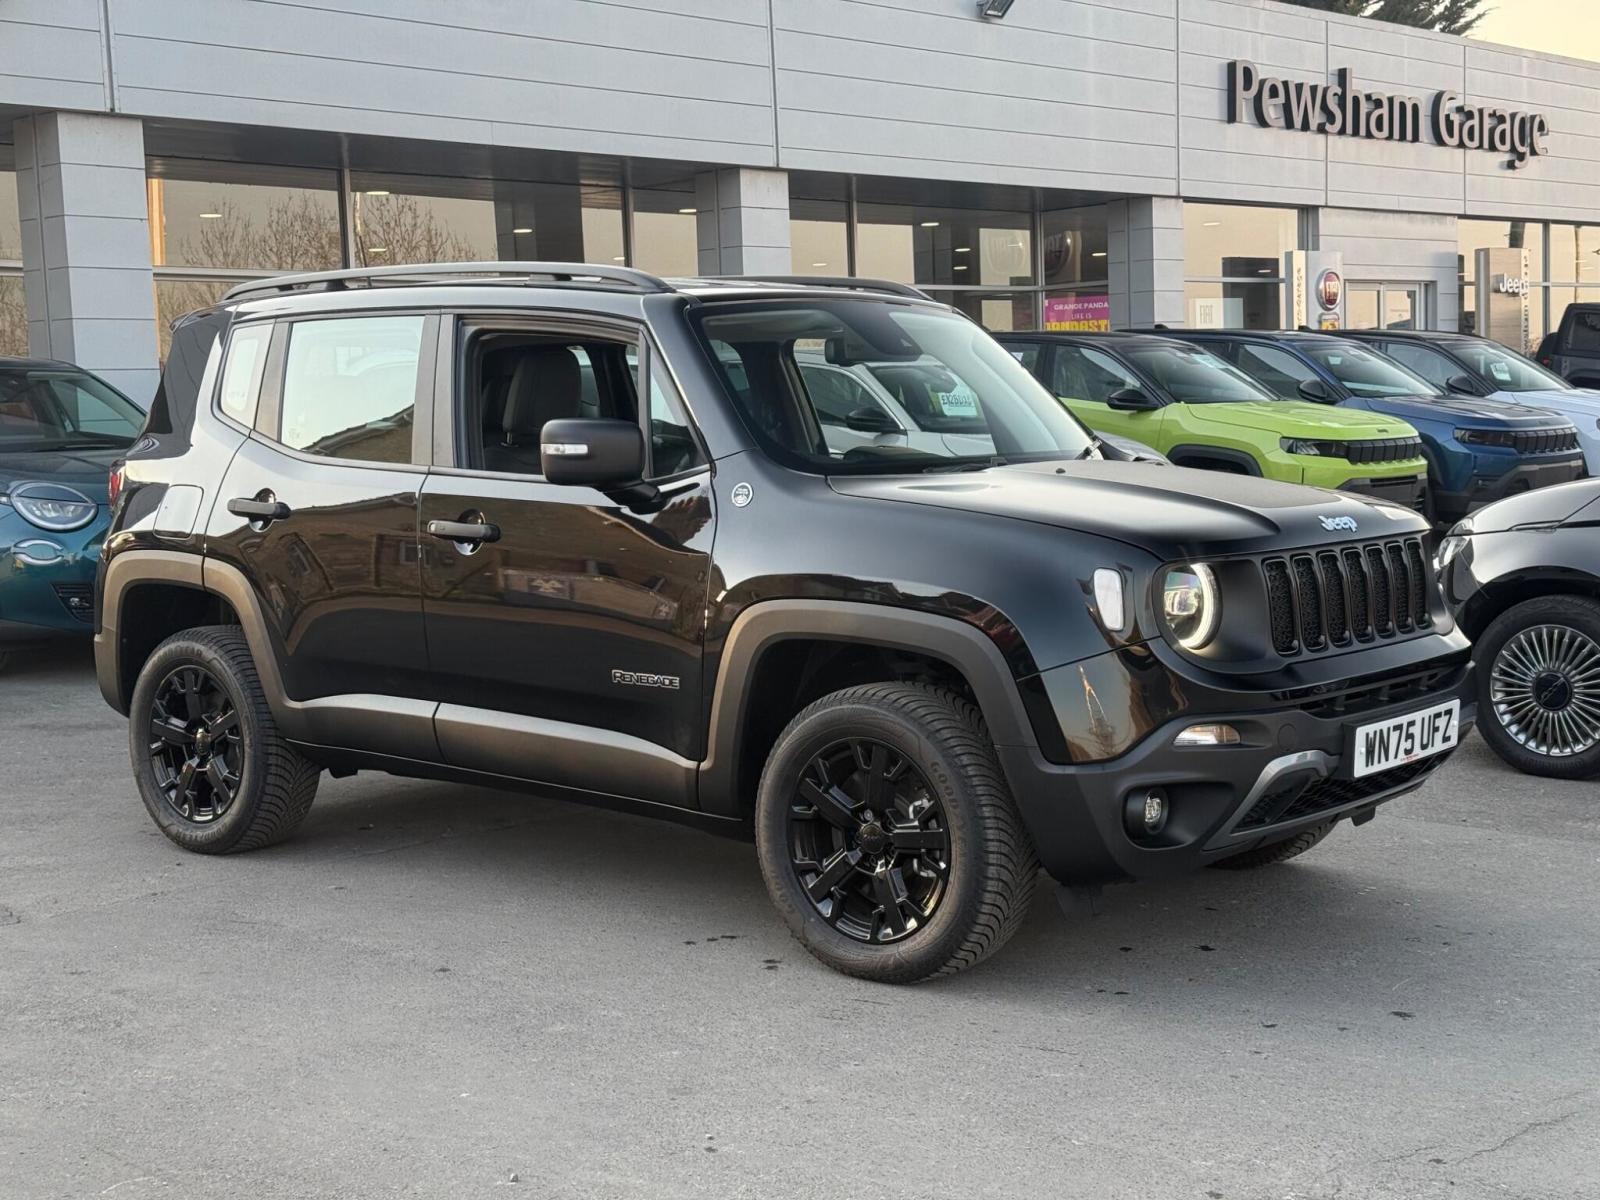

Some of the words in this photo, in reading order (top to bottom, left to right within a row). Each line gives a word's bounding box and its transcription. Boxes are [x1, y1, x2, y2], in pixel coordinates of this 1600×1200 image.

[1227, 59, 1426, 143] Pewsham
[1431, 89, 1550, 170] Garage
[1499, 273, 1528, 297] Jeep
[1053, 303, 1083, 311] GRANDE
[1083, 302, 1109, 310] PANDA
[1317, 514, 1358, 533] Jeep
[611, 669, 680, 690] RENEGADE
[1364, 719, 1417, 768] WN75
[1420, 707, 1454, 750] UFZ
